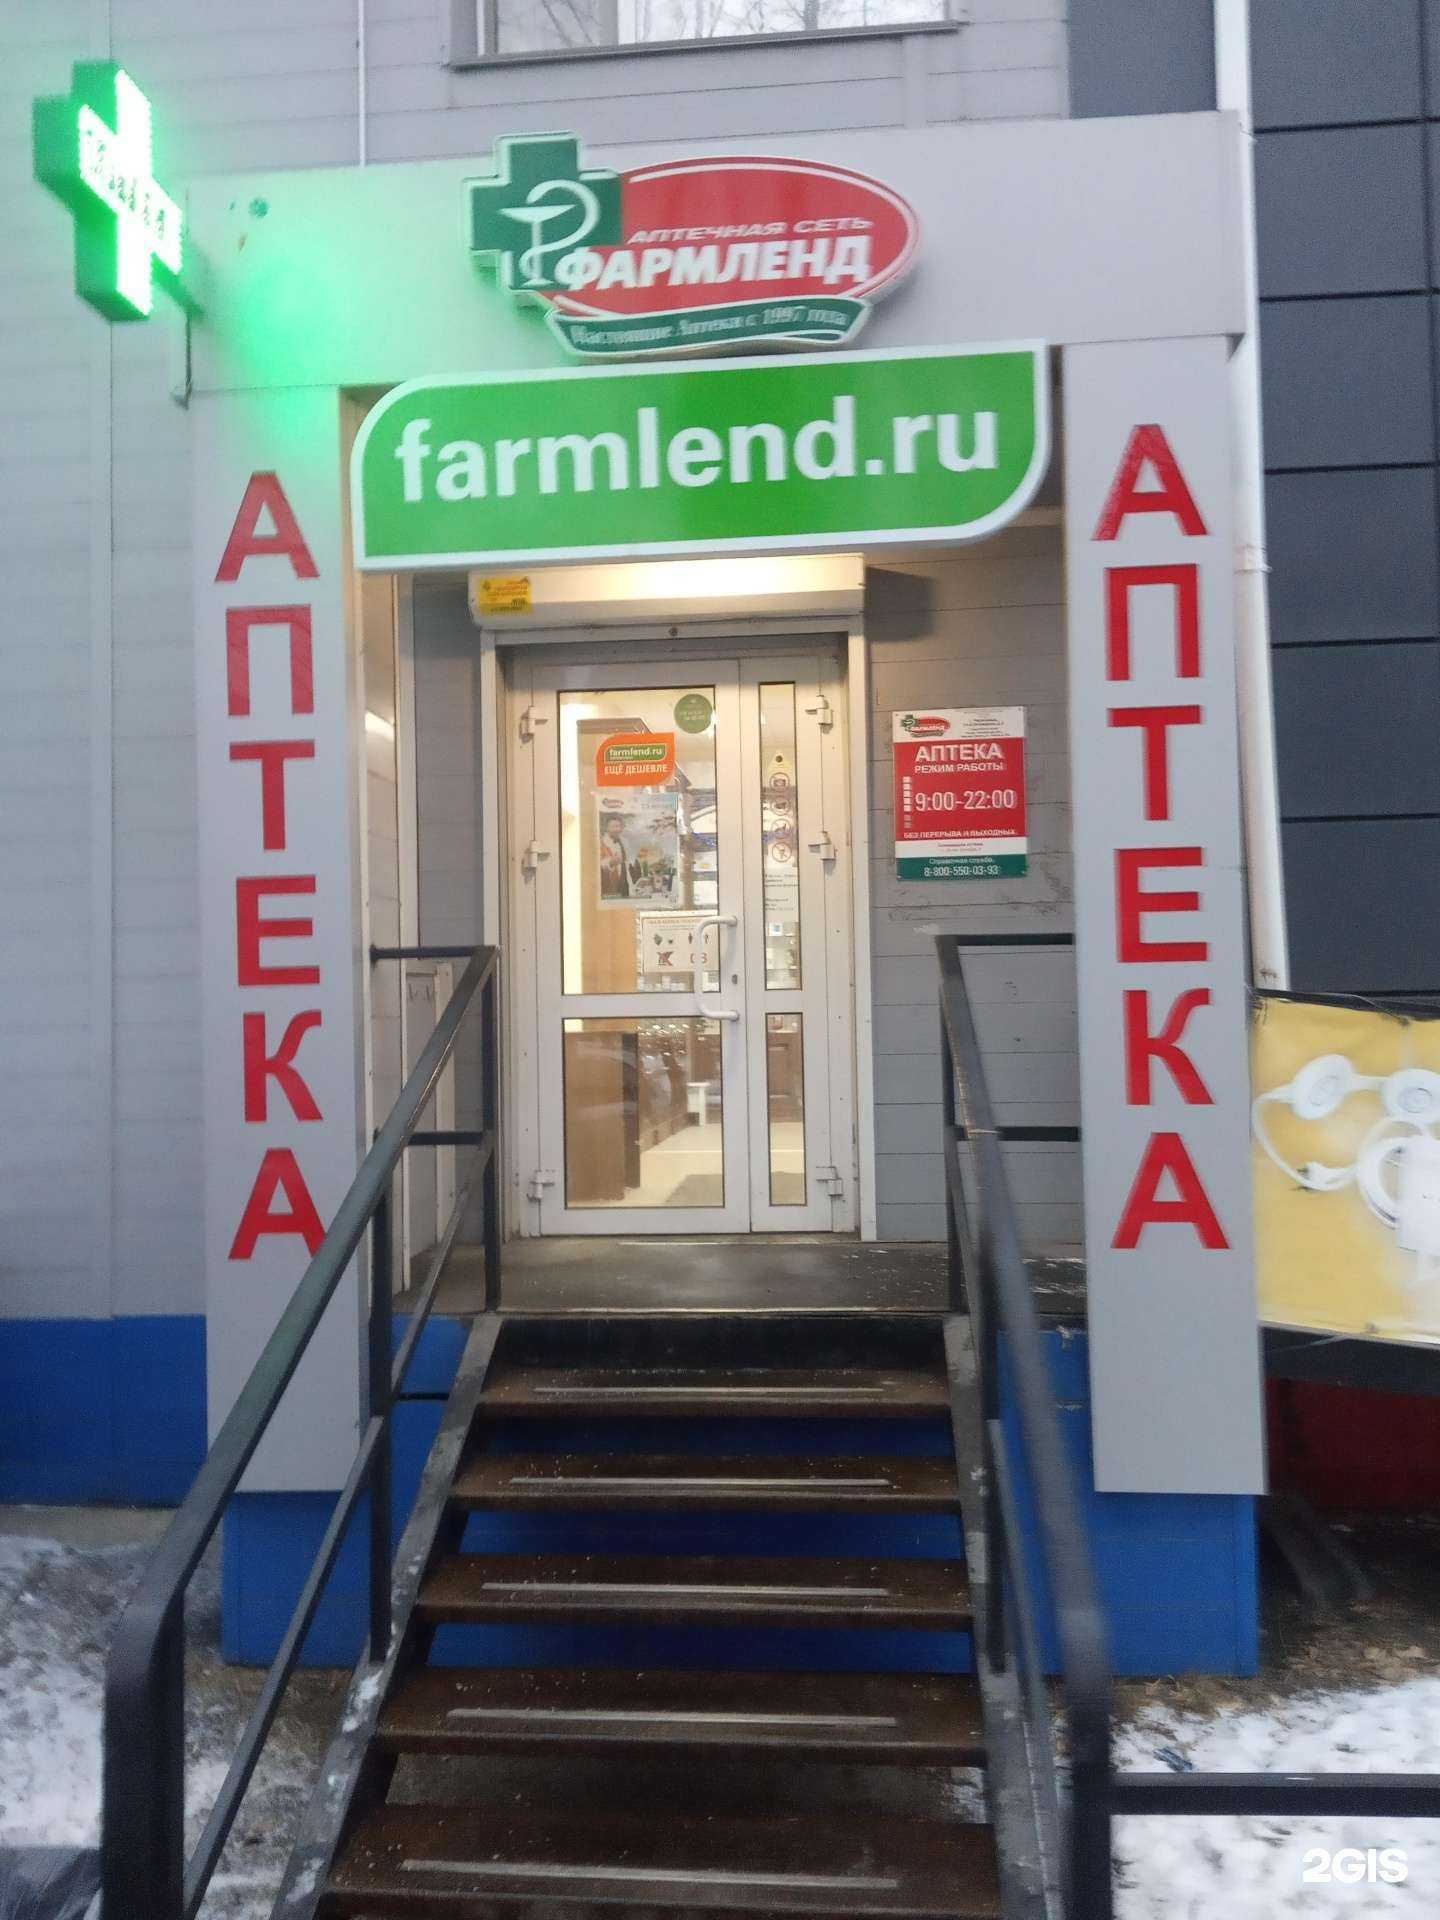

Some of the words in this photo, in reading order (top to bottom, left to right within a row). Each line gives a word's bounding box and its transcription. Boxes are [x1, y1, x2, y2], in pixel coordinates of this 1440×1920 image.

[627, 223, 787, 245] АПТЕЧНАЯ
[793, 217, 874, 233] СЕТЬ
[554, 234, 871, 291] ФАРМЛЕНД
[395, 395, 999, 502] farmlend.ru
[914, 764, 954, 773] РЕЖИМ
[957, 762, 1004, 771] РАБОТЫ
[915, 743, 1004, 762] АПТЕКА
[915, 789, 1015, 811] 9:00-22:00
[1091, 424, 1230, 1249] АПТЕКА
[215, 470, 325, 1261] АПТЕКА
